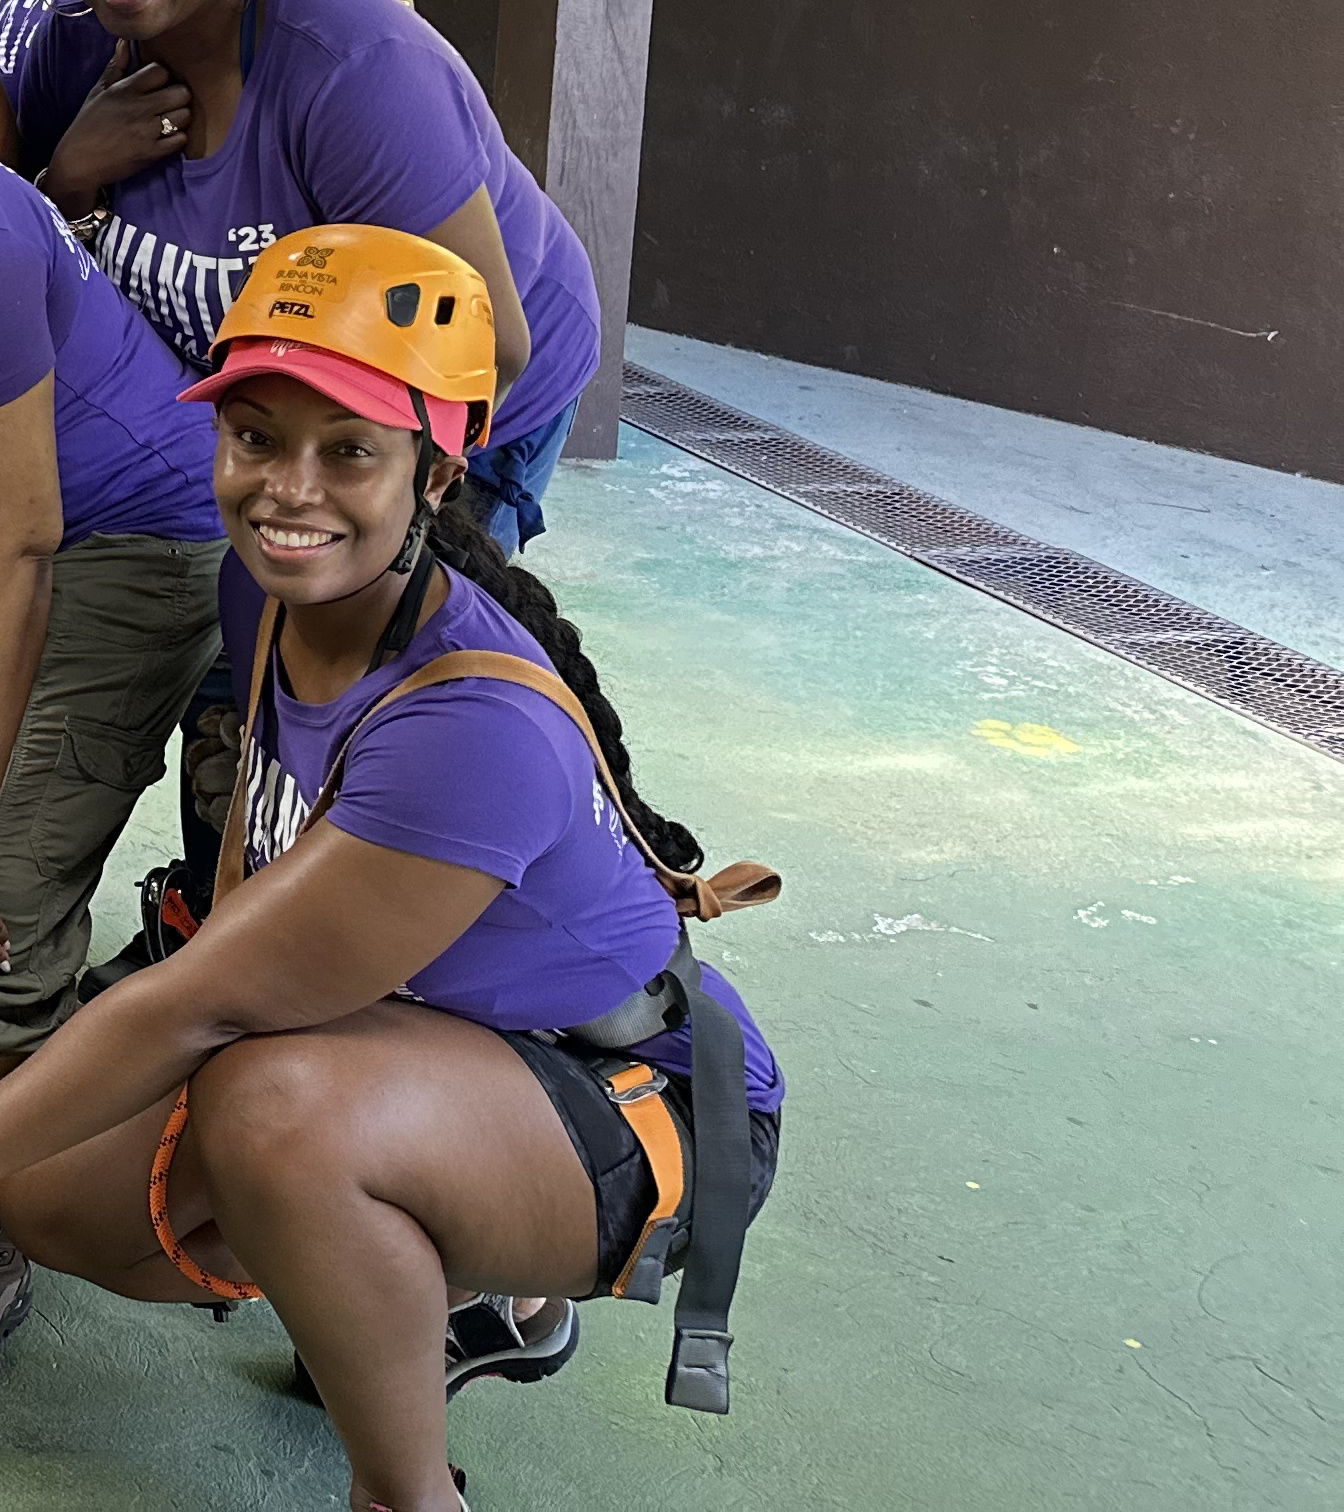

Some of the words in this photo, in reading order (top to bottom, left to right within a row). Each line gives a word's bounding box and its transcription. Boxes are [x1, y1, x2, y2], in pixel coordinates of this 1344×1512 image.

[228, 223, 277, 251] '23
[95, 215, 258, 344] WANTE
[276, 270, 309, 280] BUENA
[310, 271, 338, 285] VISTA
[278, 283, 324, 296] RINCON
[269, 301, 315, 318] PETZL
